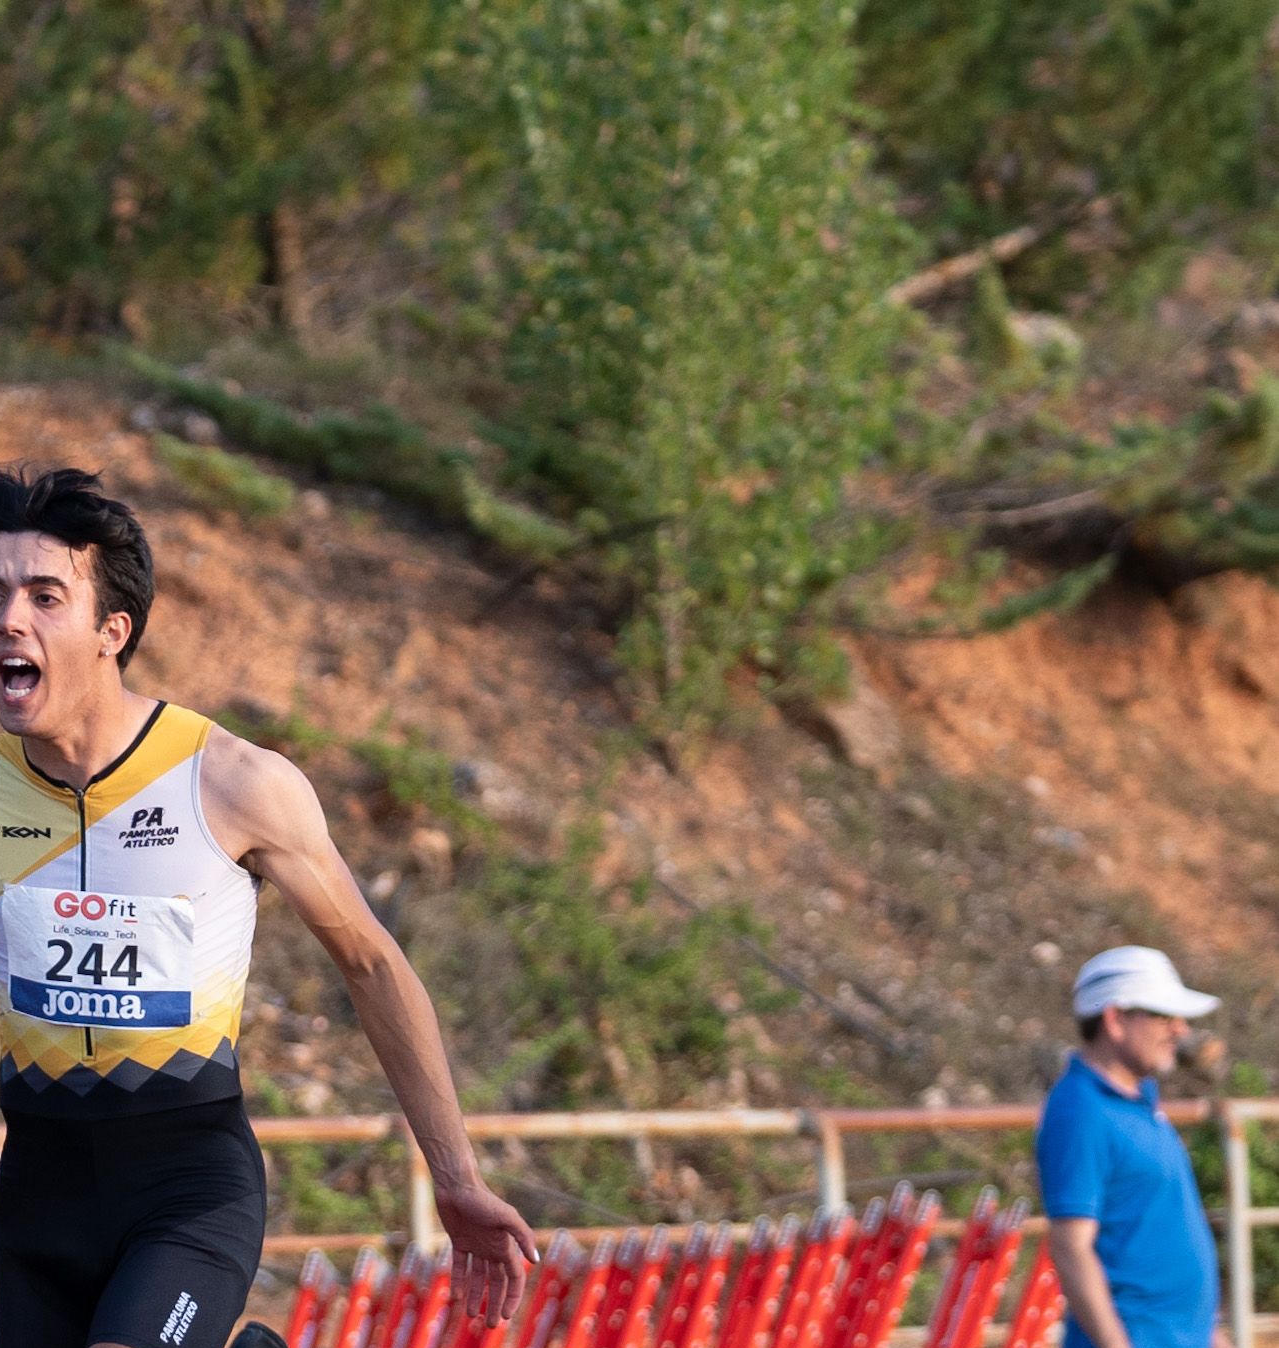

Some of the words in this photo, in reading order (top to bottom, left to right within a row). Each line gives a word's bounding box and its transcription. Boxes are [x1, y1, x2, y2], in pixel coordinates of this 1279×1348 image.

[118, 826, 179, 840] PAMPLONA
[131, 807, 163, 829] PA
[46, 939, 143, 986] 244
[160, 1291, 191, 1343] PAMPLONA
